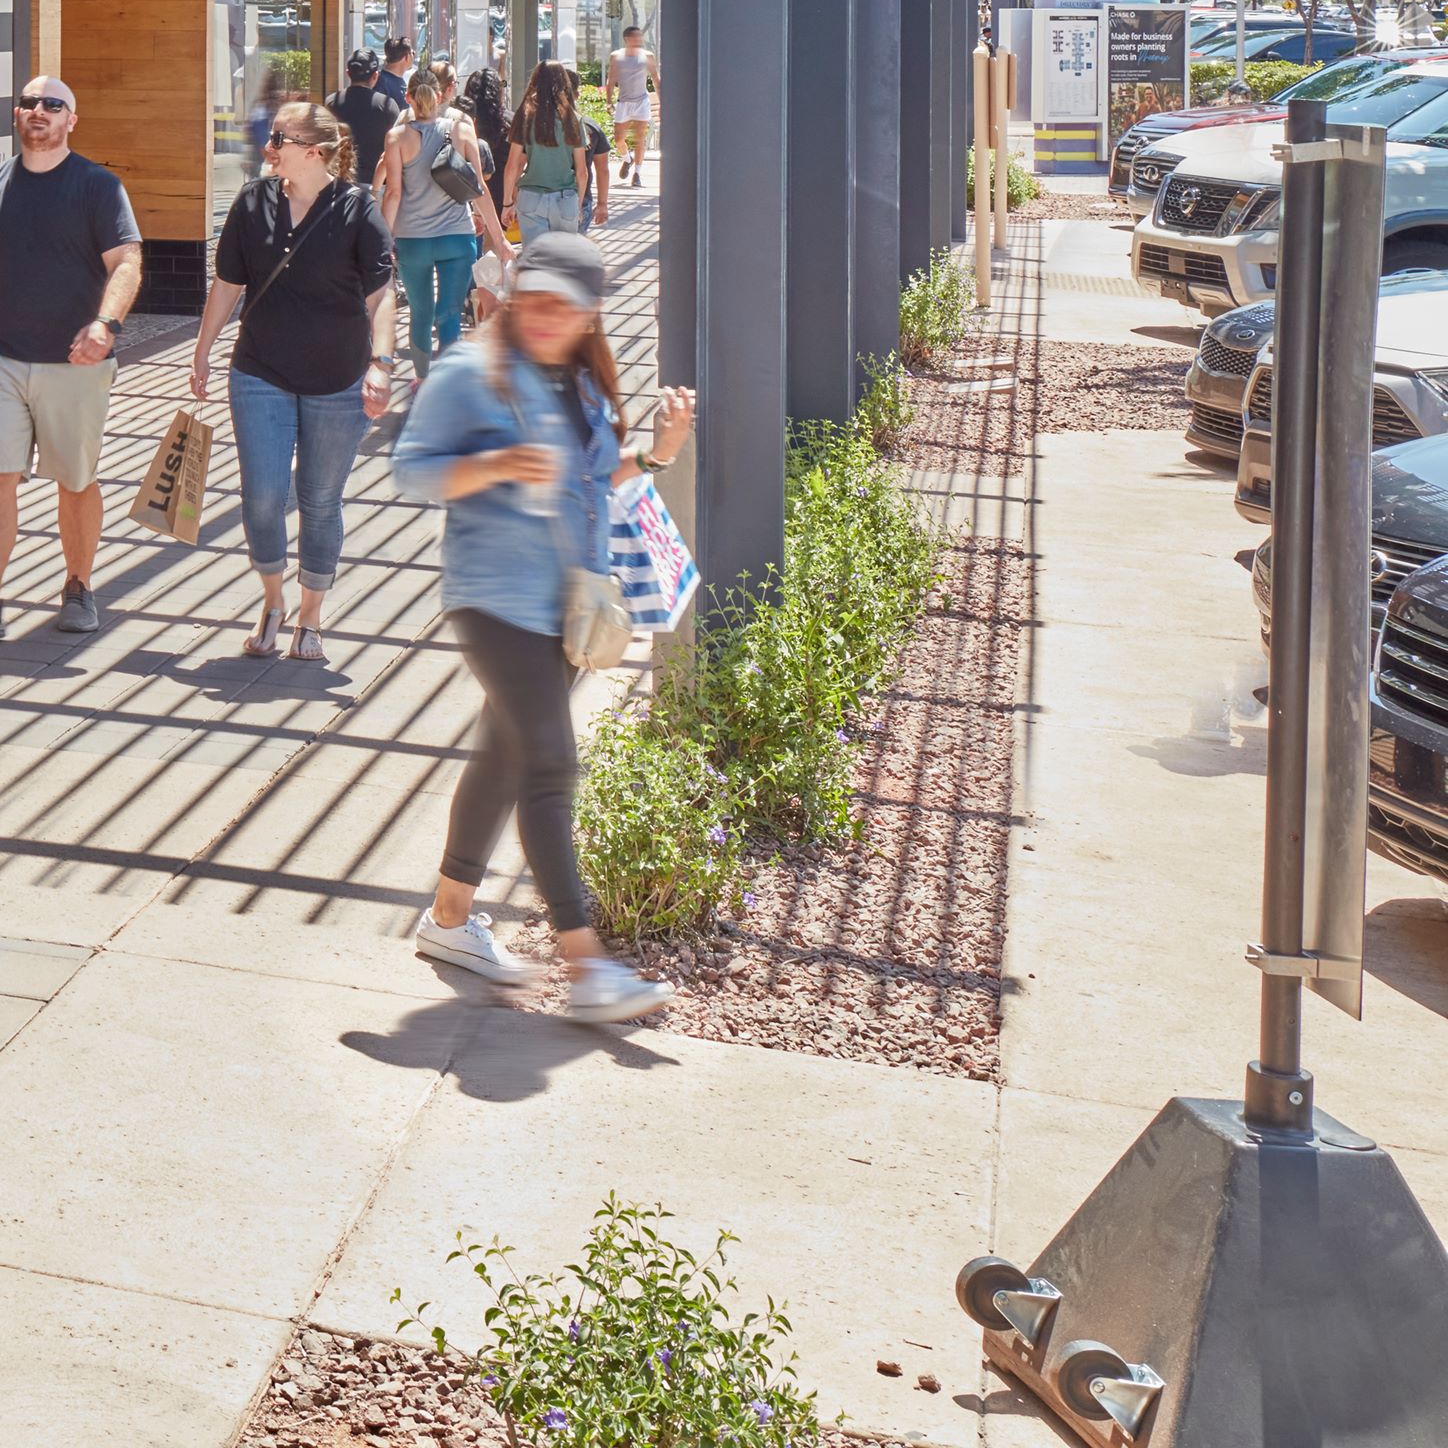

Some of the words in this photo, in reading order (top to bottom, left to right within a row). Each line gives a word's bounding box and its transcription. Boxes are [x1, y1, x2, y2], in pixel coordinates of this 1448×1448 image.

[1110, 32, 1130, 41] Made
[1131, 32, 1141, 41] for
[1143, 32, 1173, 41] business
[1137, 43, 1166, 53] planting
[1110, 53, 1129, 61] roots
[1129, 52, 1137, 61] in
[147, 430, 189, 512] LUSH
